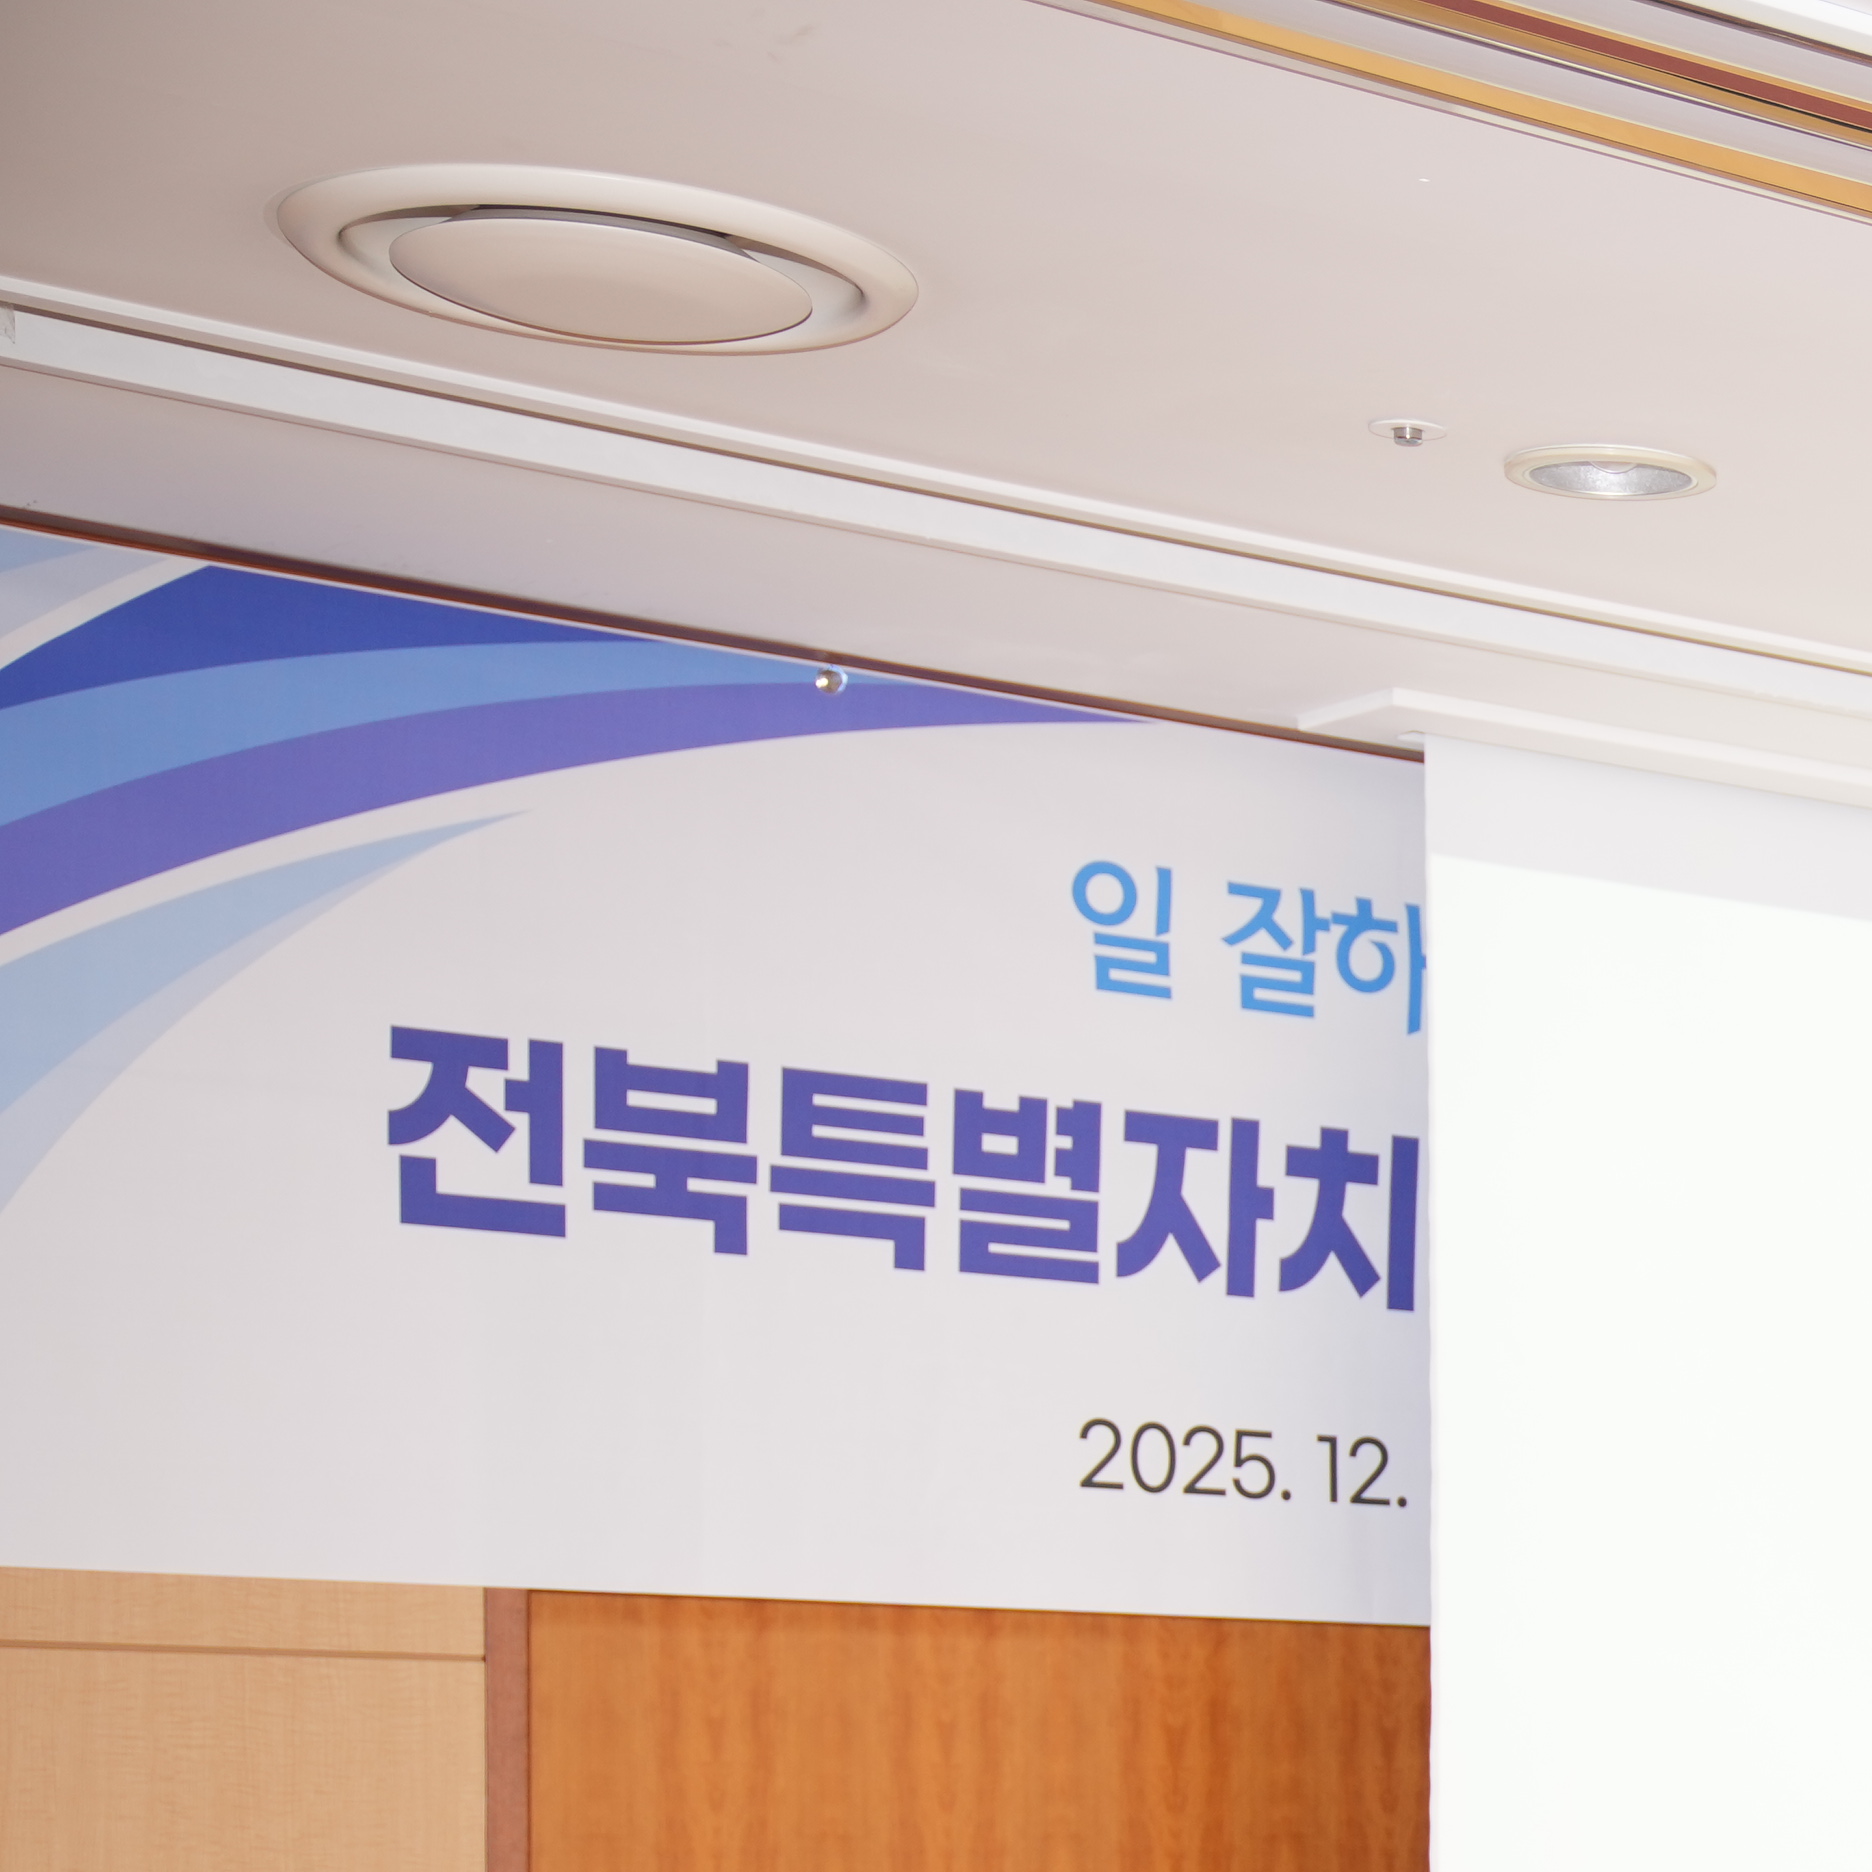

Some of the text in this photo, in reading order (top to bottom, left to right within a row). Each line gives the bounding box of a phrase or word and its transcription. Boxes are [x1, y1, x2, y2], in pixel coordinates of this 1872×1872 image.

[1072, 860, 1173, 999] 일
[388, 1024, 1420, 1312] 전북특별자치
[1080, 1418, 1407, 1508] 2025. 12.
